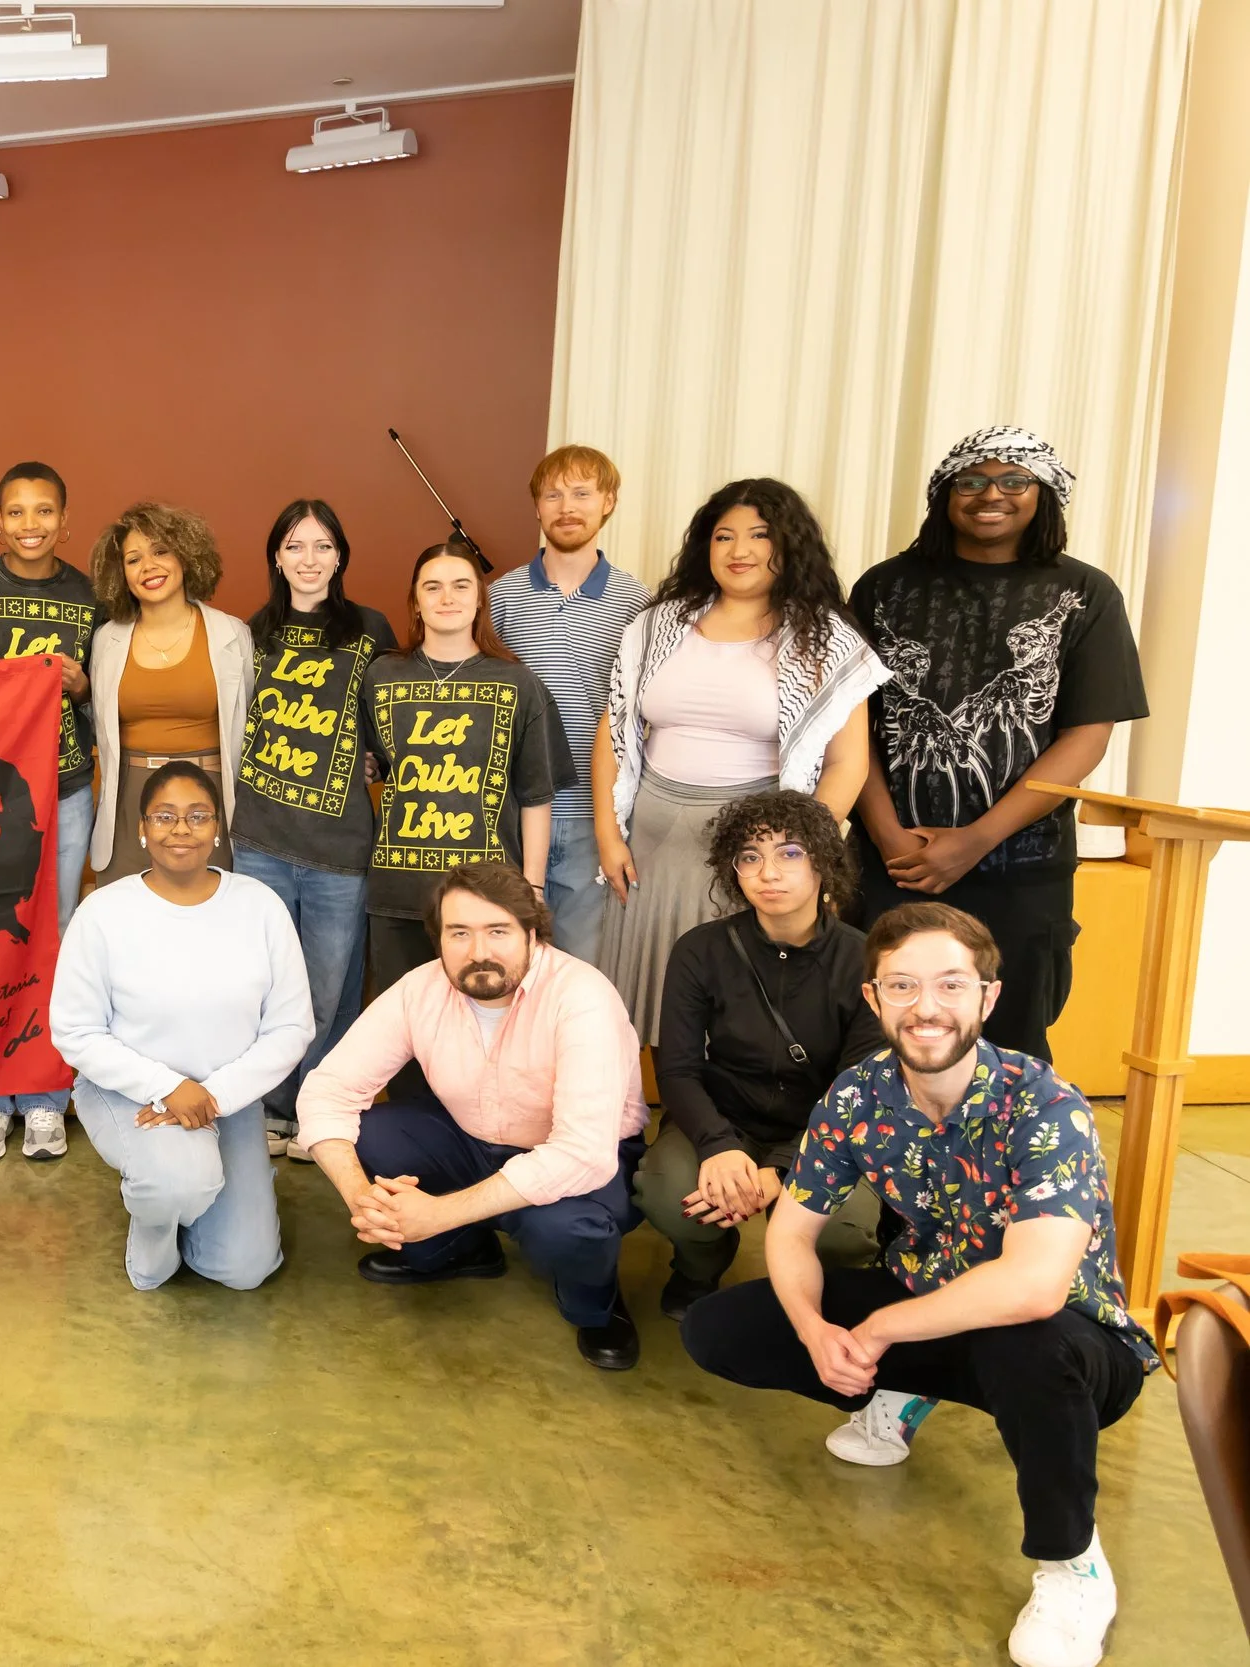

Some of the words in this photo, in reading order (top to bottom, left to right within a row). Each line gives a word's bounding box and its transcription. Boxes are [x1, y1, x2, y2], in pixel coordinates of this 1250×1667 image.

[271, 649, 334, 687] Let
[258, 688, 337, 736] Cuba
[407, 711, 473, 745] Let
[255, 730, 318, 777] Live
[398, 753, 481, 794] Cuba
[398, 802, 474, 840] Live
